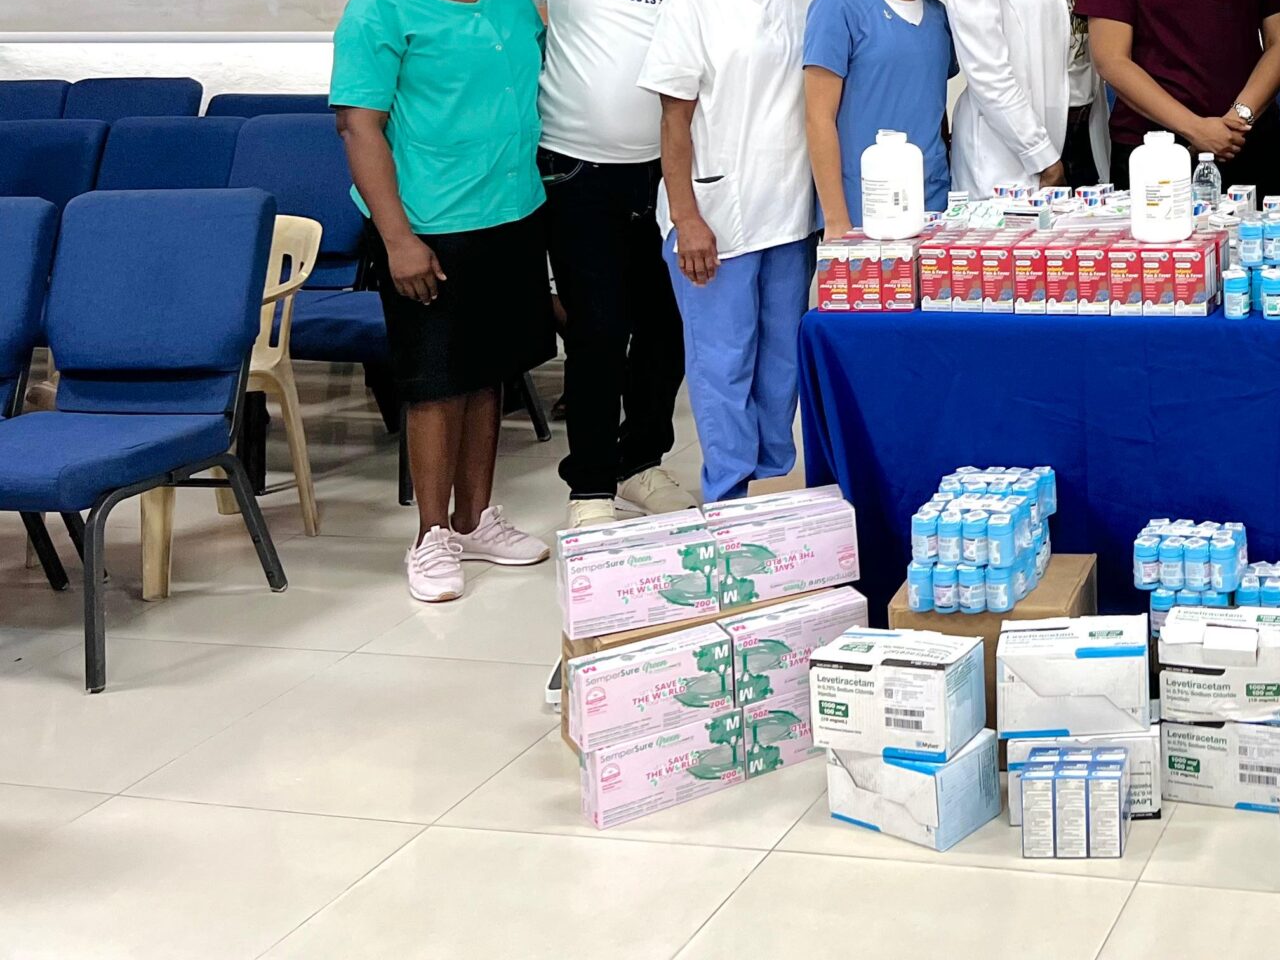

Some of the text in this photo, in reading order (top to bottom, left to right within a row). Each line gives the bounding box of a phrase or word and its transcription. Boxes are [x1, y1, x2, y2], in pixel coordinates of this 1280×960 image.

[640, 575, 662, 586] SAVE
[617, 588, 634, 597] THE
[694, 599, 711, 608] 200
[655, 680, 677, 691] SAVE
[817, 674, 875, 688] Levetiracetam
[1166, 678, 1231, 690] Levetiracetam
[632, 696, 650, 706] THE
[710, 700, 726, 709] 200
[1167, 730, 1227, 745] Levetiracetam
[668, 753, 689, 765] SAVE
[646, 770, 663, 780] THE
[721, 771, 737, 780] 200
